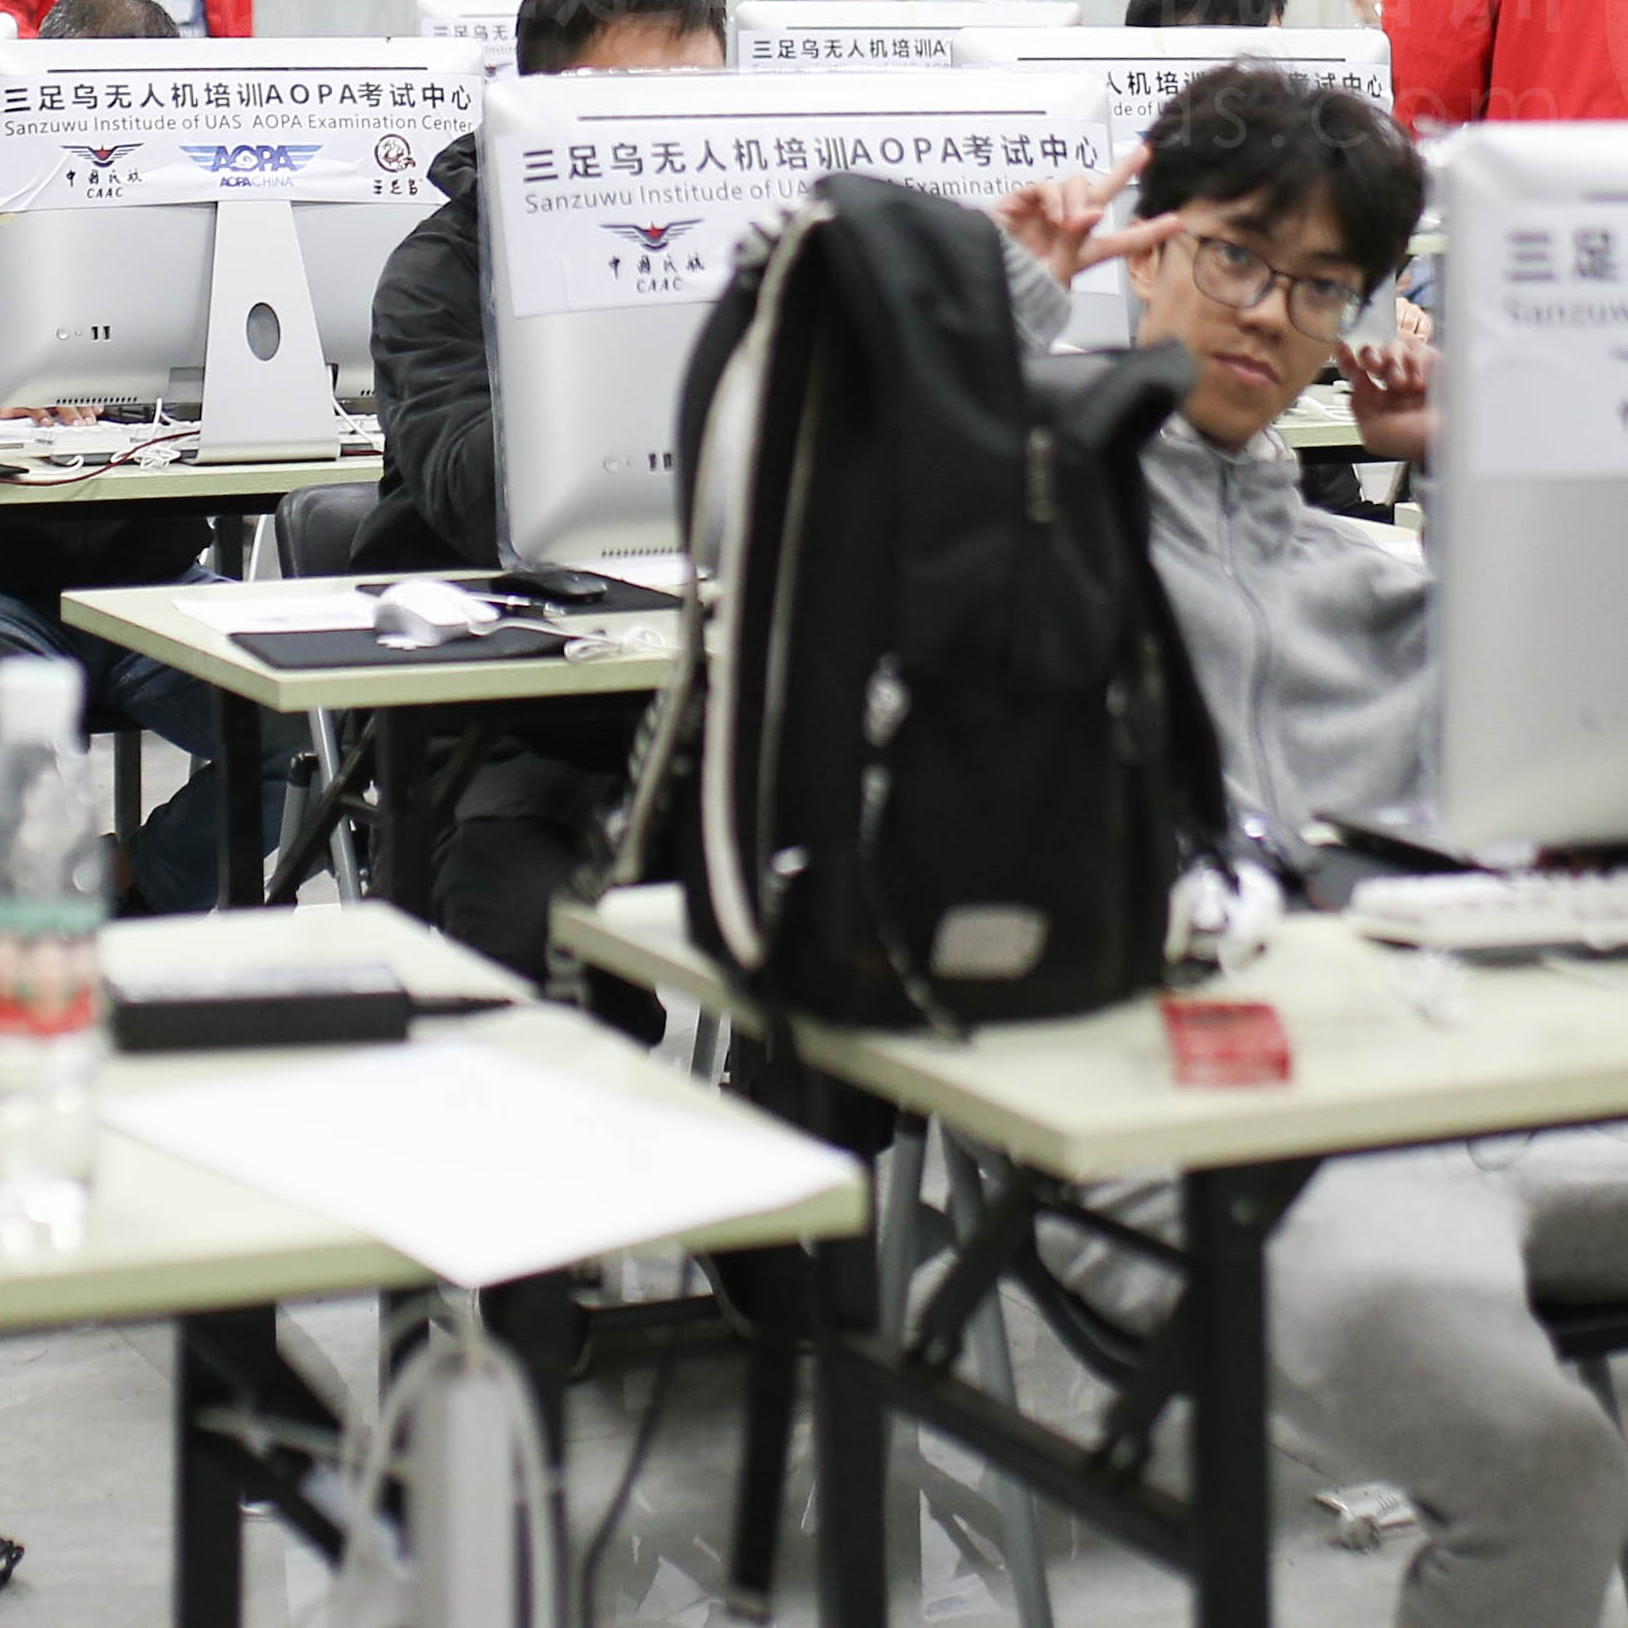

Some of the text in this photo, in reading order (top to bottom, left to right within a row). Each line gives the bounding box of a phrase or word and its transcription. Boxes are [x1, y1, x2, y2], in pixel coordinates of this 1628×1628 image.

[3, 83, 473, 115] 三足乌无人机培训AOPA考试中心
[4, 114, 474, 138] Sanzuwu Institude of UAS AOPA Examination Center
[211, 144, 301, 172] AOPA
[522, 133, 1099, 184] 三足乌无人机培训AOPA考试中心
[85, 187, 124, 199] CAAC
[525, 188, 632, 215] Sanzuwu
[639, 182, 743, 206] Institude
[750, 180, 772, 200] of
[778, 179, 812, 200] UA
[636, 277, 683, 293] CAAC
